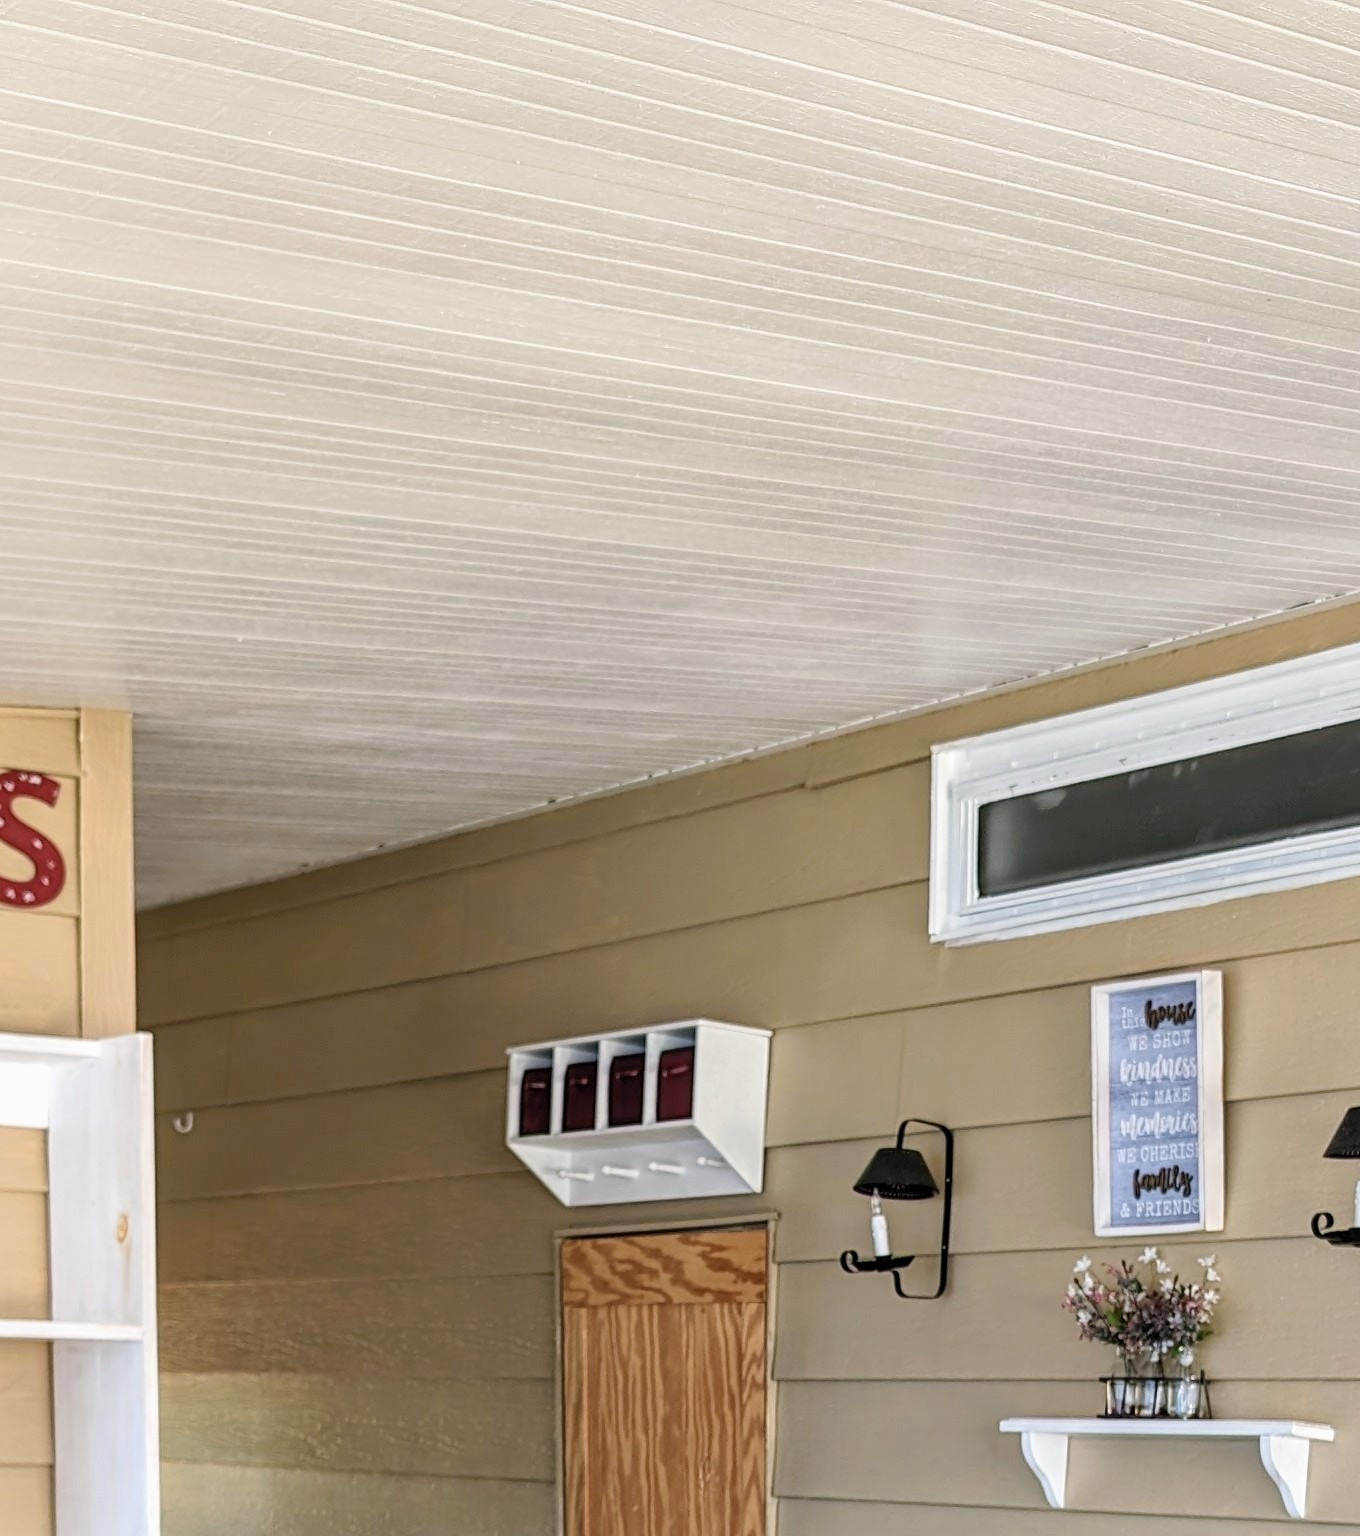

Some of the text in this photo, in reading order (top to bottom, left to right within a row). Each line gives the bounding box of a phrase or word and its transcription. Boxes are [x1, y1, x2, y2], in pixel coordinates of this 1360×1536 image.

[1144, 999, 1196, 1030] house
[1127, 1029, 1191, 1051] WE SHOW
[1120, 1054, 1197, 1087] kindness
[1130, 1086, 1191, 1107] WE MAKE
[1120, 1111, 1197, 1140] memories
[1116, 1147, 1136, 1164] WE
[1133, 1165, 1193, 1200] family
[1120, 1199, 1199, 1218] & FRIENDS
